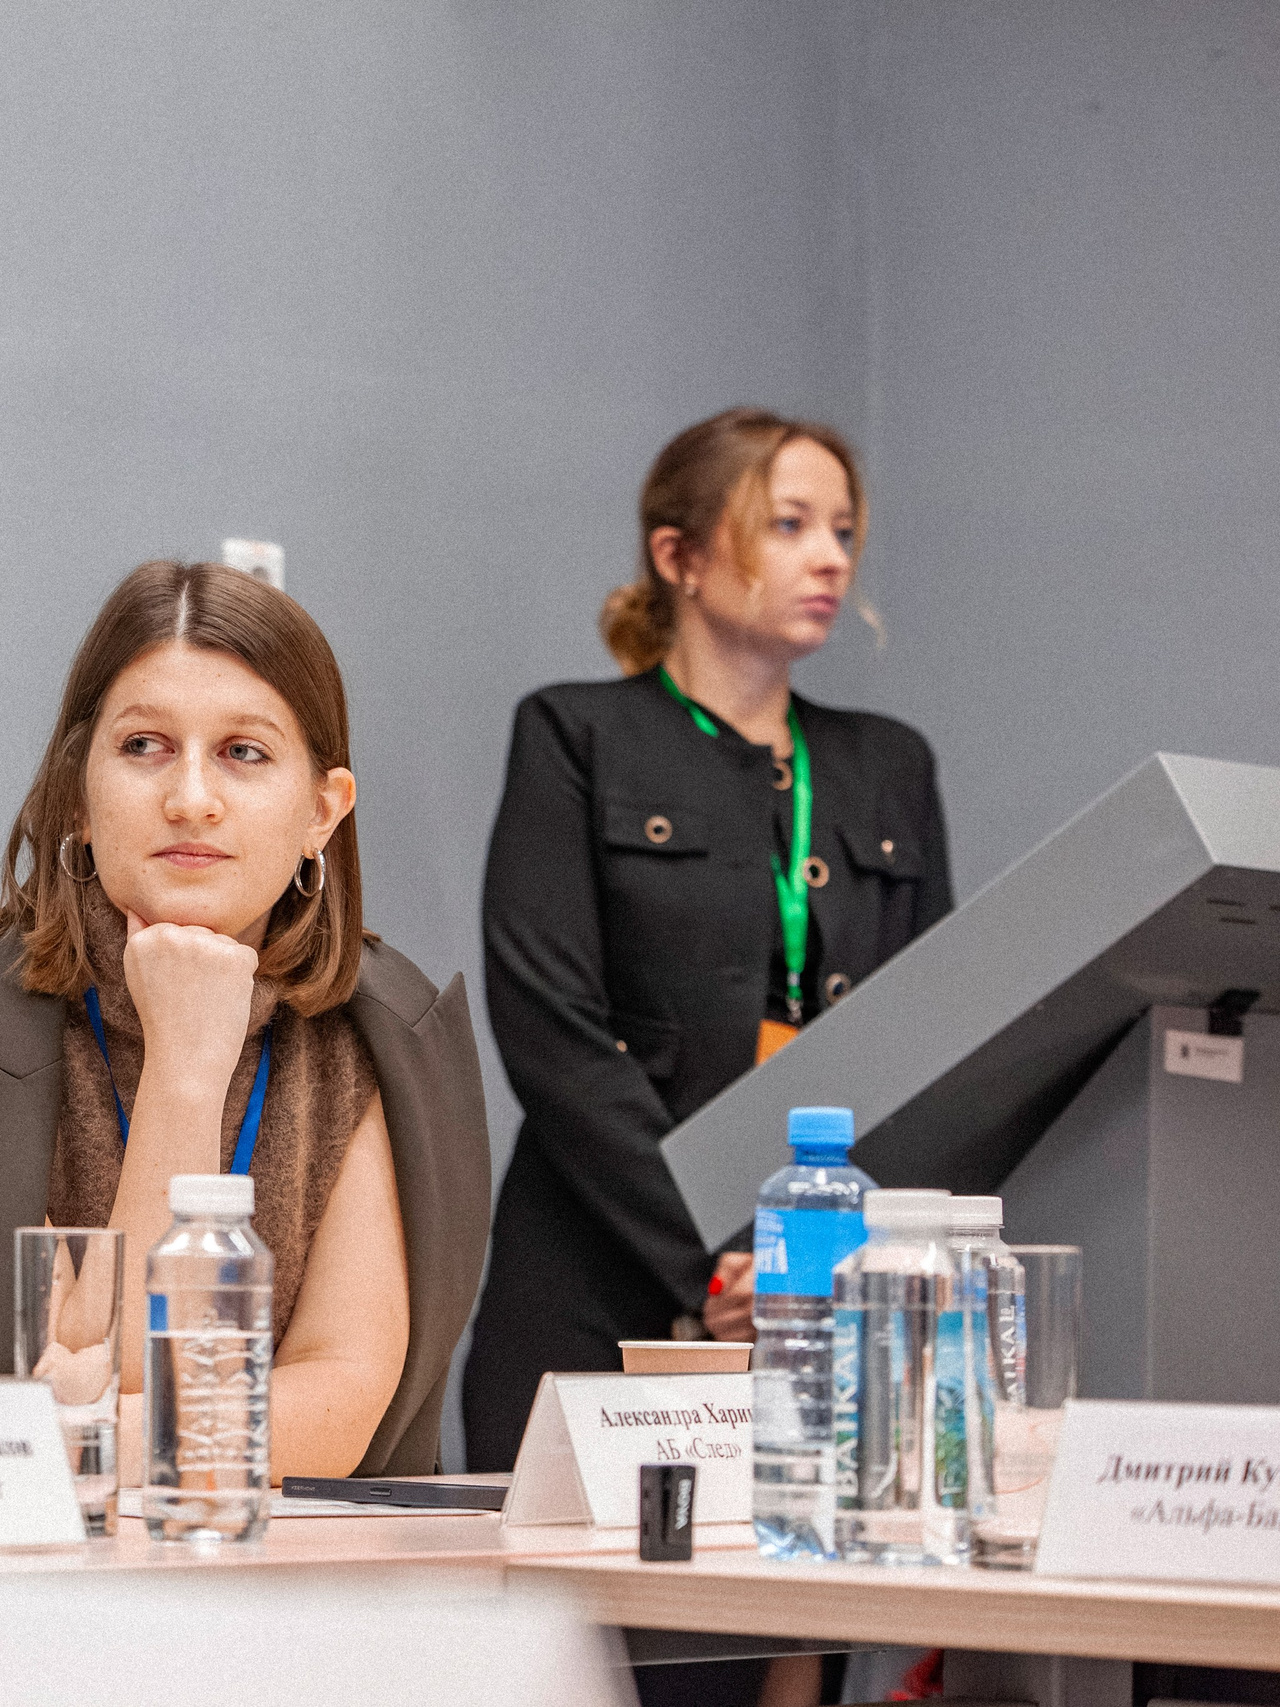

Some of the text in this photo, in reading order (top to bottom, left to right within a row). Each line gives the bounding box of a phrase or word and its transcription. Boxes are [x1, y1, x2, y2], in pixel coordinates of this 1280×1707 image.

[599, 1407, 702, 1430] Александра
[656, 1437, 742, 1461] АБ «След»
[1096, 1455, 1230, 1489] Дмитрий
